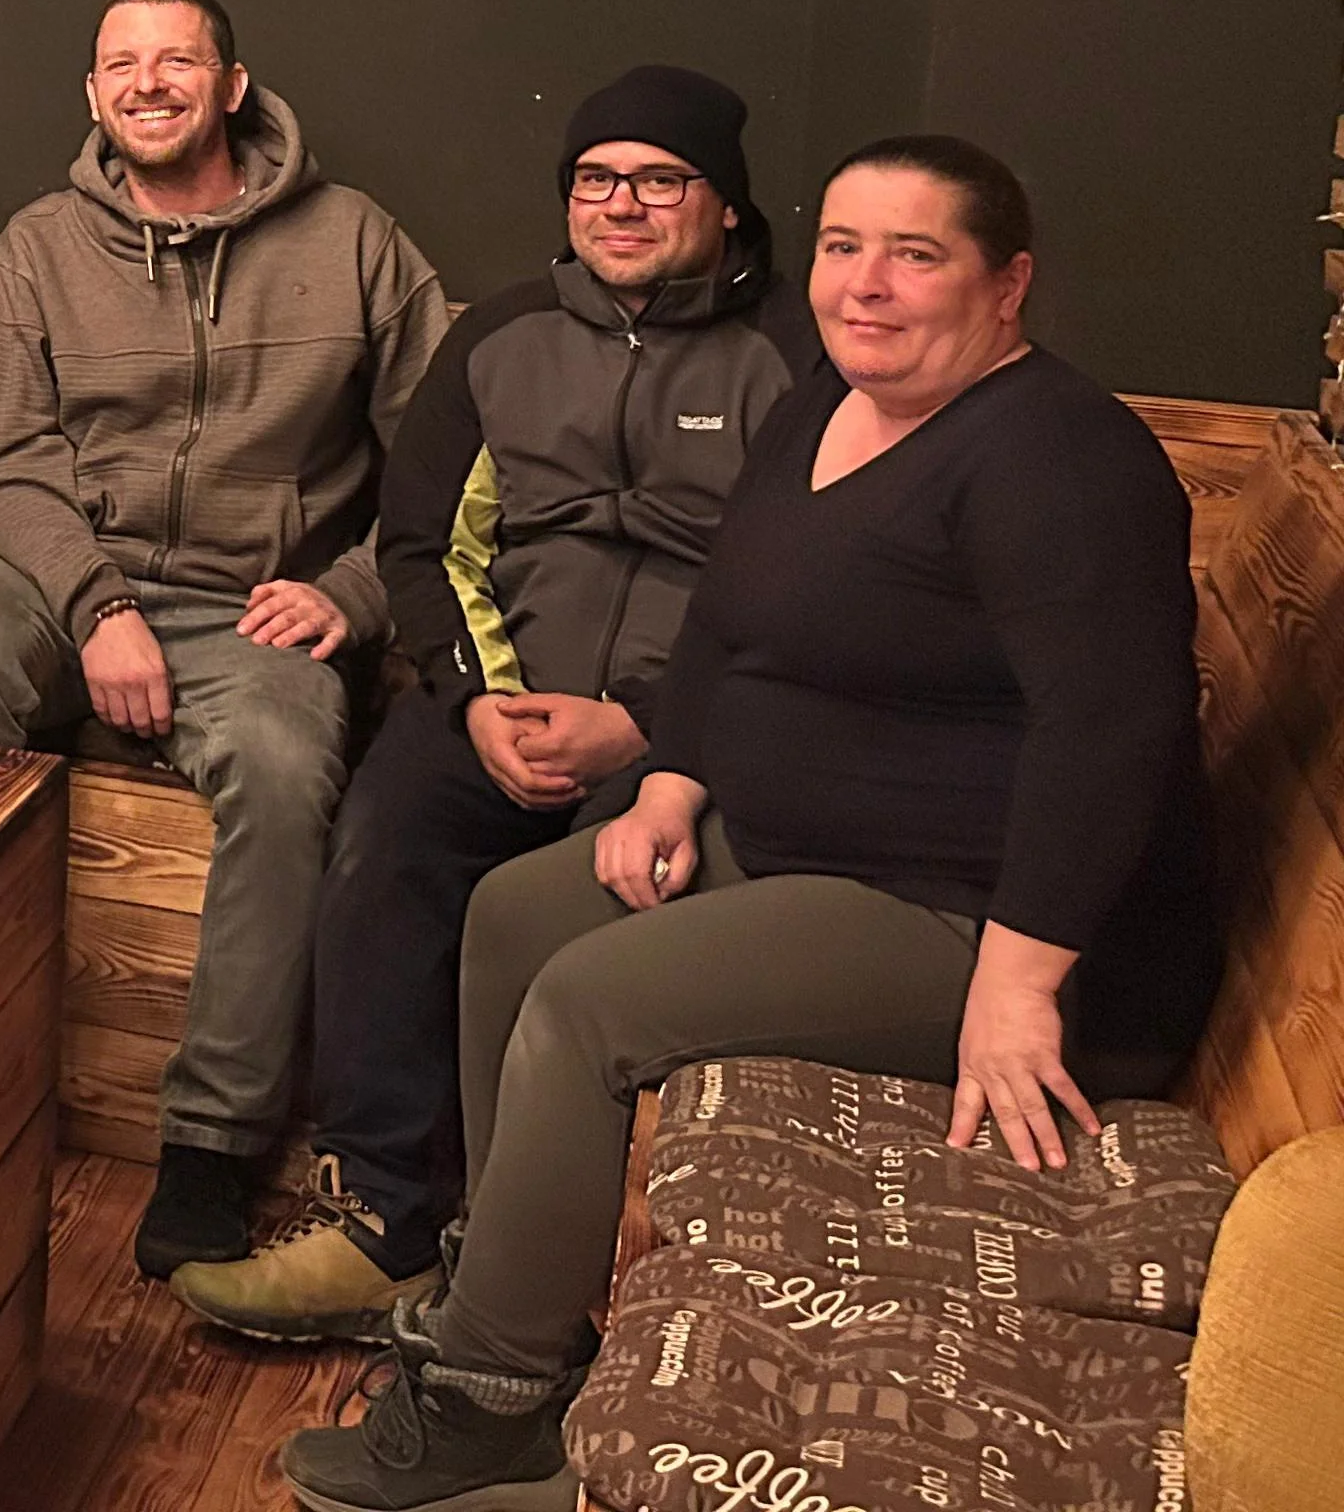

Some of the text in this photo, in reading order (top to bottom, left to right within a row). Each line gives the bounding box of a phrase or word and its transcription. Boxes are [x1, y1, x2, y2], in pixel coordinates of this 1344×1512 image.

[874, 1145, 907, 1208] offee
[826, 1221, 860, 1271] ill
[706, 1258, 900, 1330] coffee
[648, 1442, 868, 1512] offee
[912, 1464, 950, 1508] cup
[1152, 1429, 1186, 1512] Cappucc
